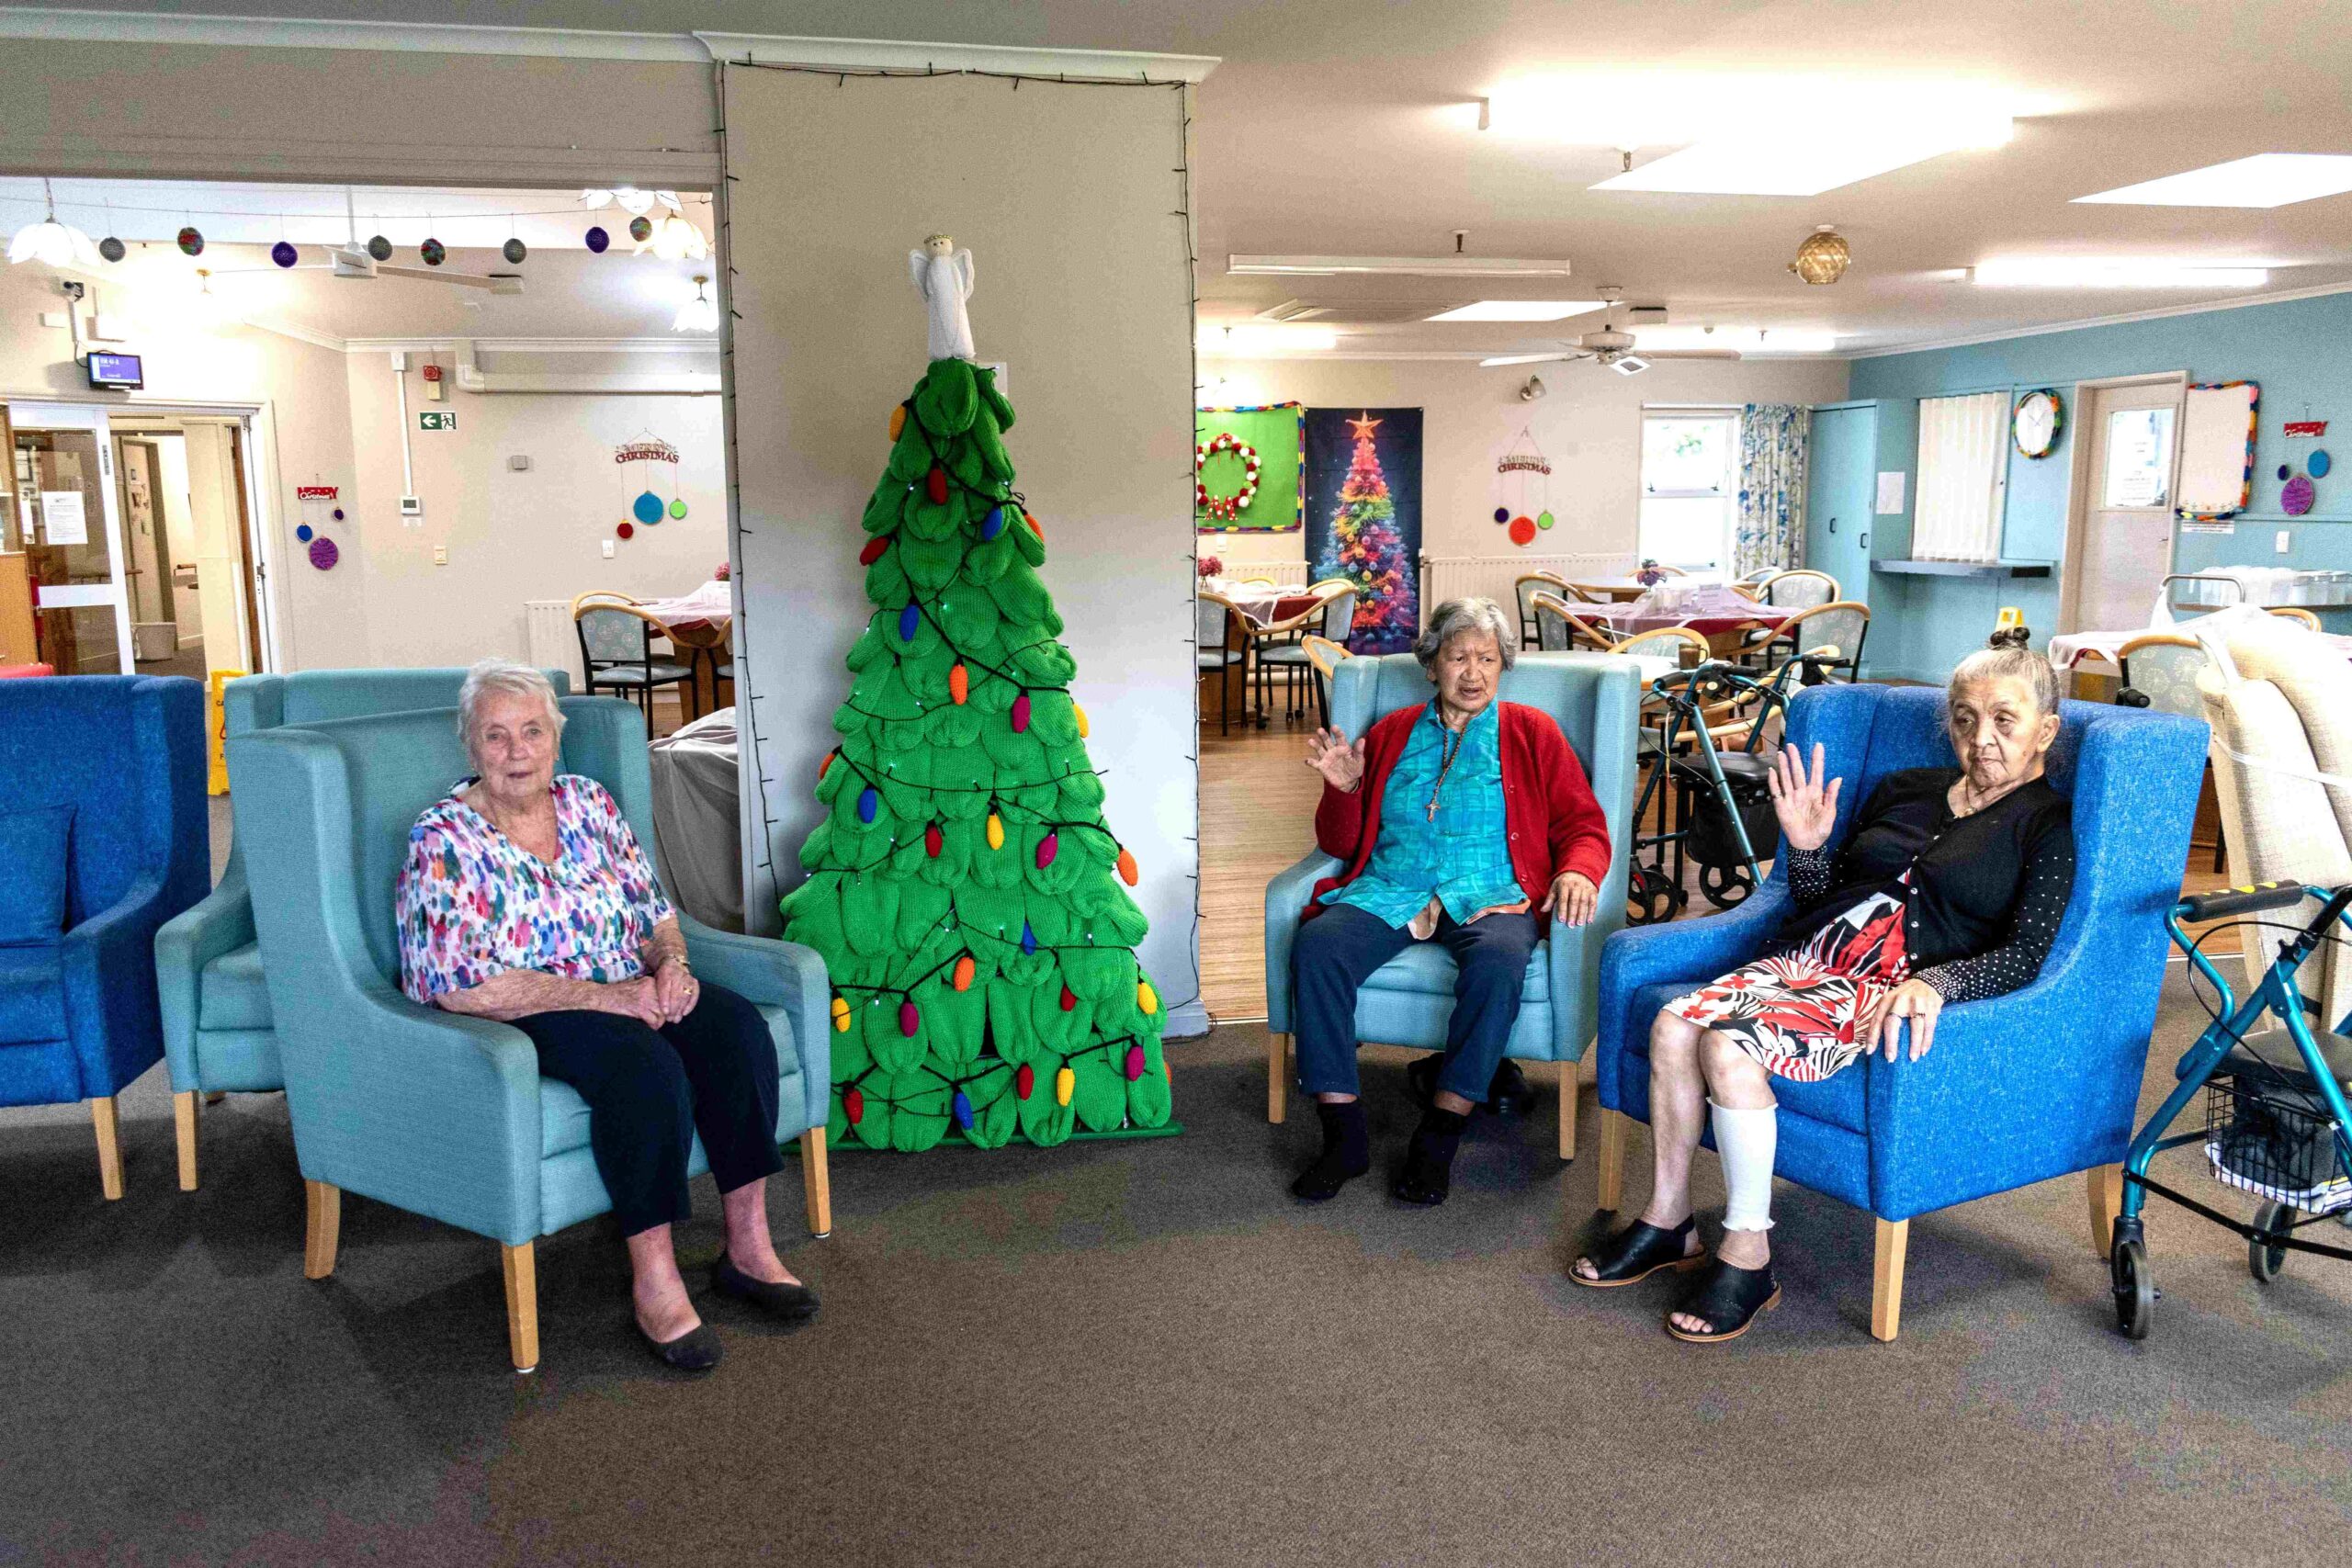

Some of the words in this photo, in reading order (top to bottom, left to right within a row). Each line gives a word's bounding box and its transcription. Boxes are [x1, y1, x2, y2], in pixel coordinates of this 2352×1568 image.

[616, 451, 680, 464] CHRISTMAS
[1498, 462, 1552, 476] CHRISTMAS
[1204, 495, 1238, 521] M
